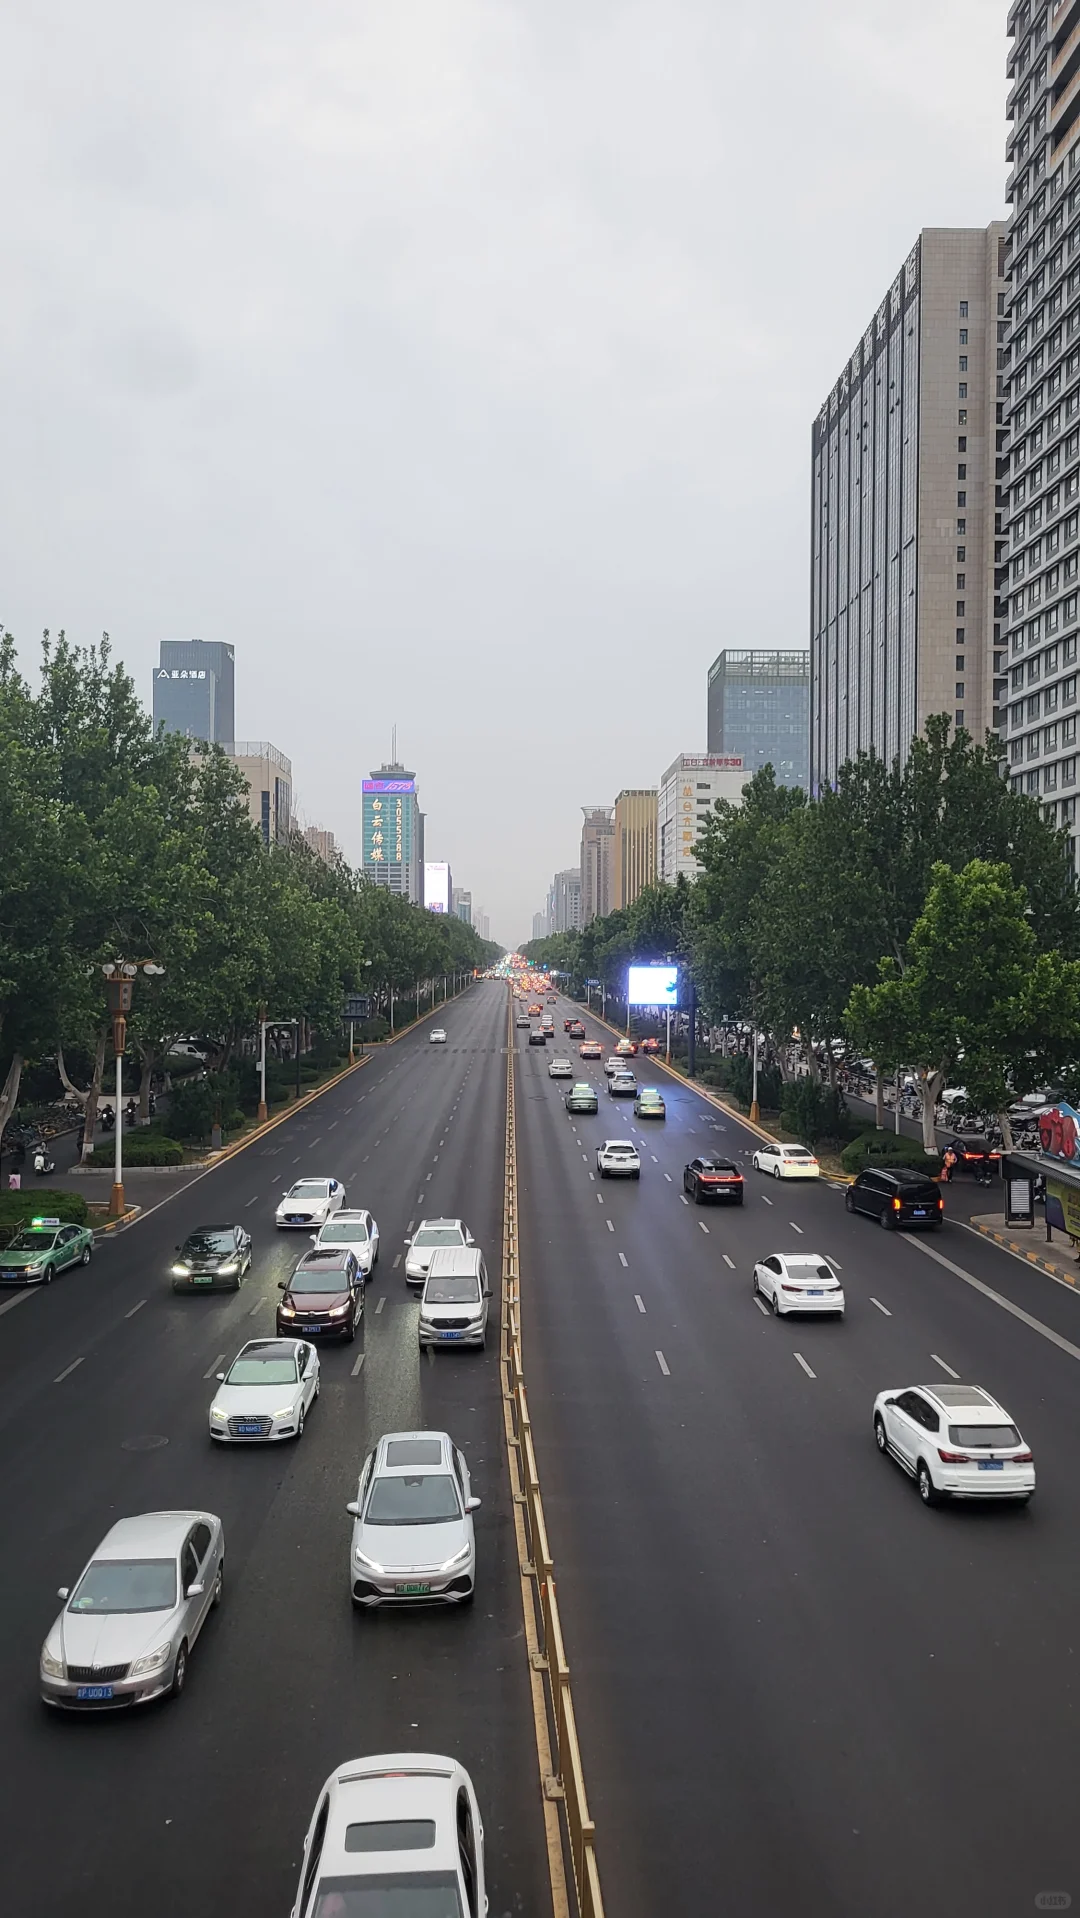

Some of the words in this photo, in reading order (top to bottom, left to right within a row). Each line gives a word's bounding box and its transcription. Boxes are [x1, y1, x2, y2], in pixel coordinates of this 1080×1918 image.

[171, 669, 206, 679] 亚朵酒店
[370, 799, 384, 861] 白云传媒
